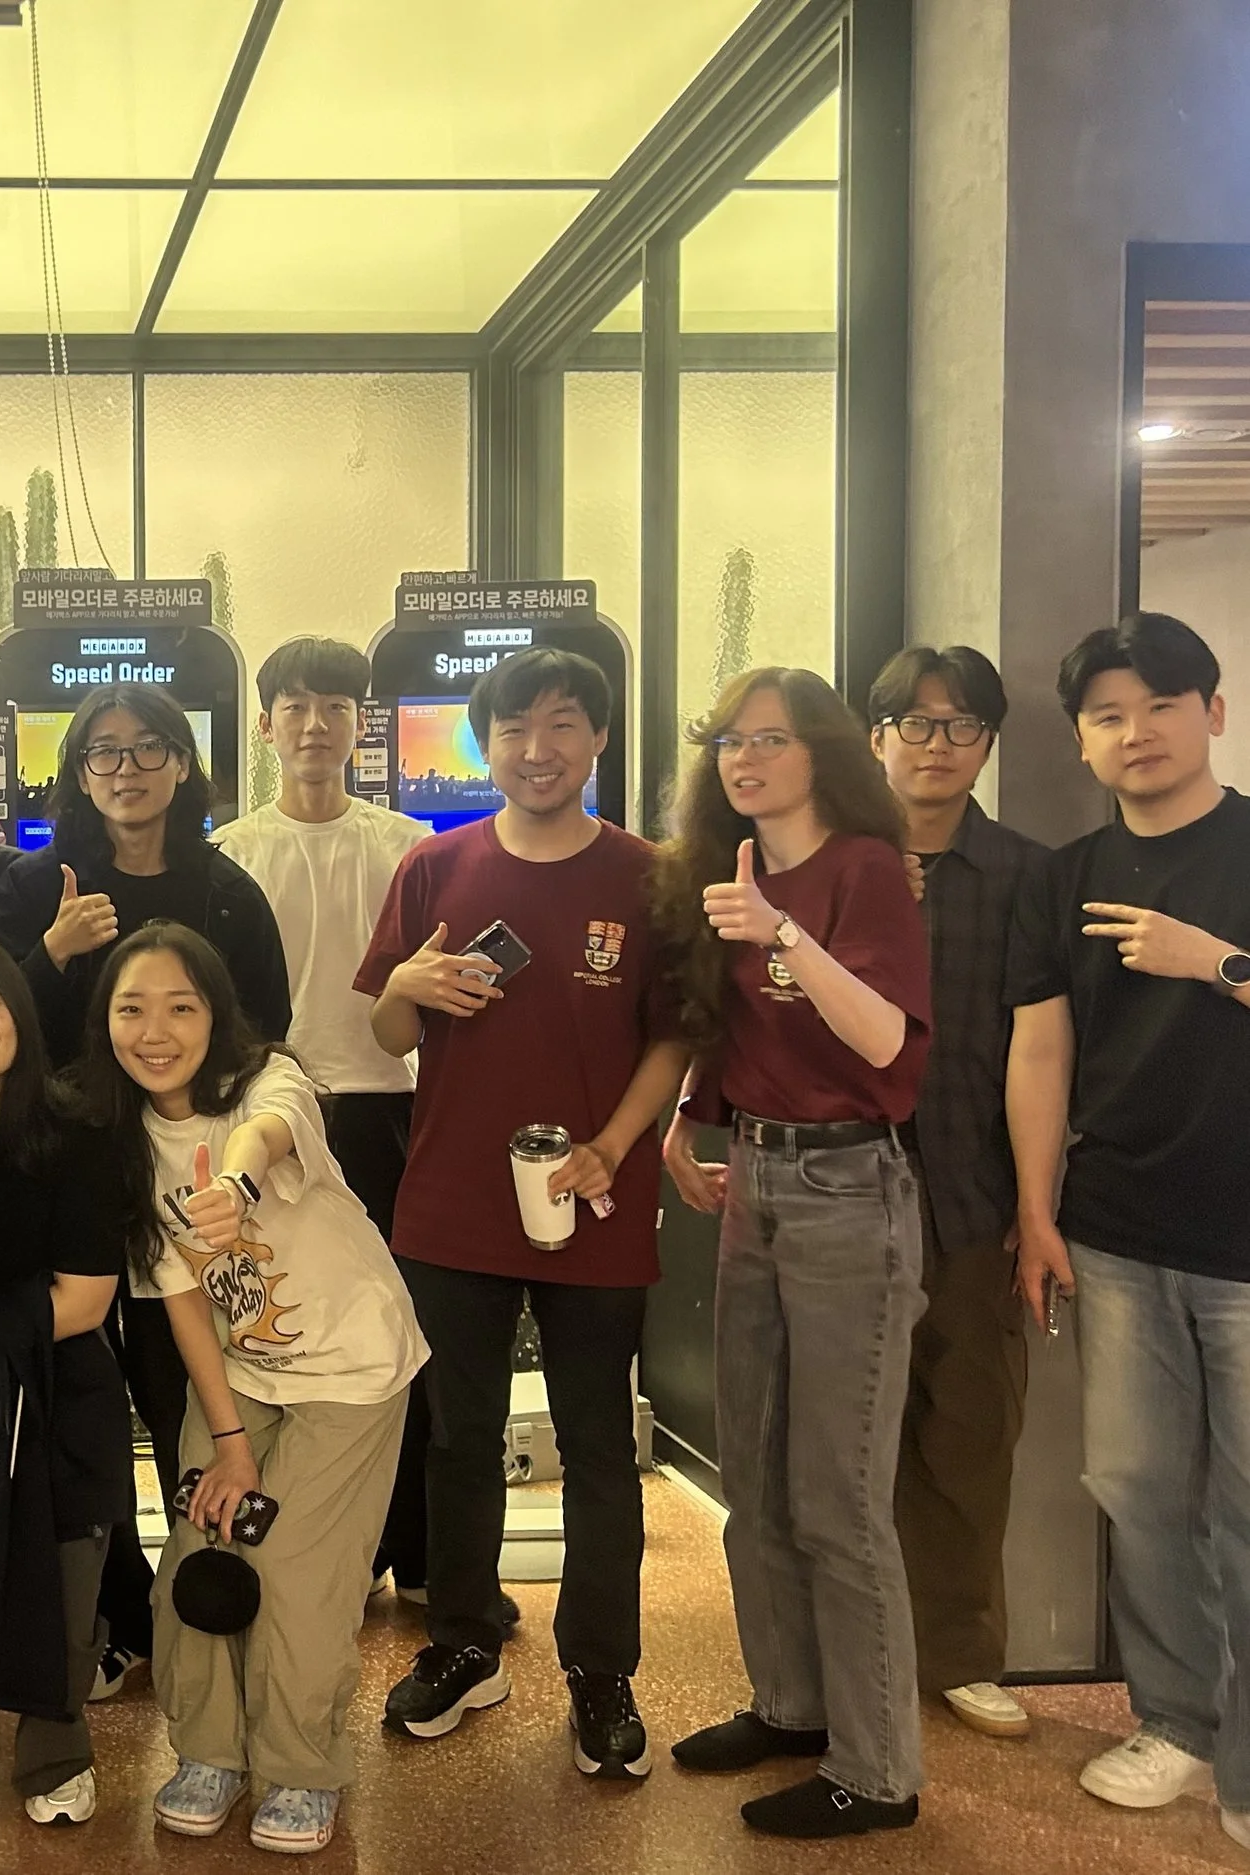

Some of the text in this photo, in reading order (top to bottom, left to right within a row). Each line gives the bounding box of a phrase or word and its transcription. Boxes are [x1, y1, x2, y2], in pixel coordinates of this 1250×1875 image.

[21, 569, 50, 583] 앞사람
[21, 587, 204, 608] 모바일오더로 주문하세요
[403, 588, 589, 611] 모바일오더로 주문하세요
[82, 641, 144, 652] MEGABOX
[466, 632, 530, 644] MEGABOX
[435, 652, 498, 679] Speed
[52, 662, 175, 688] Speed Order
[585, 979, 609, 987] LONDON
